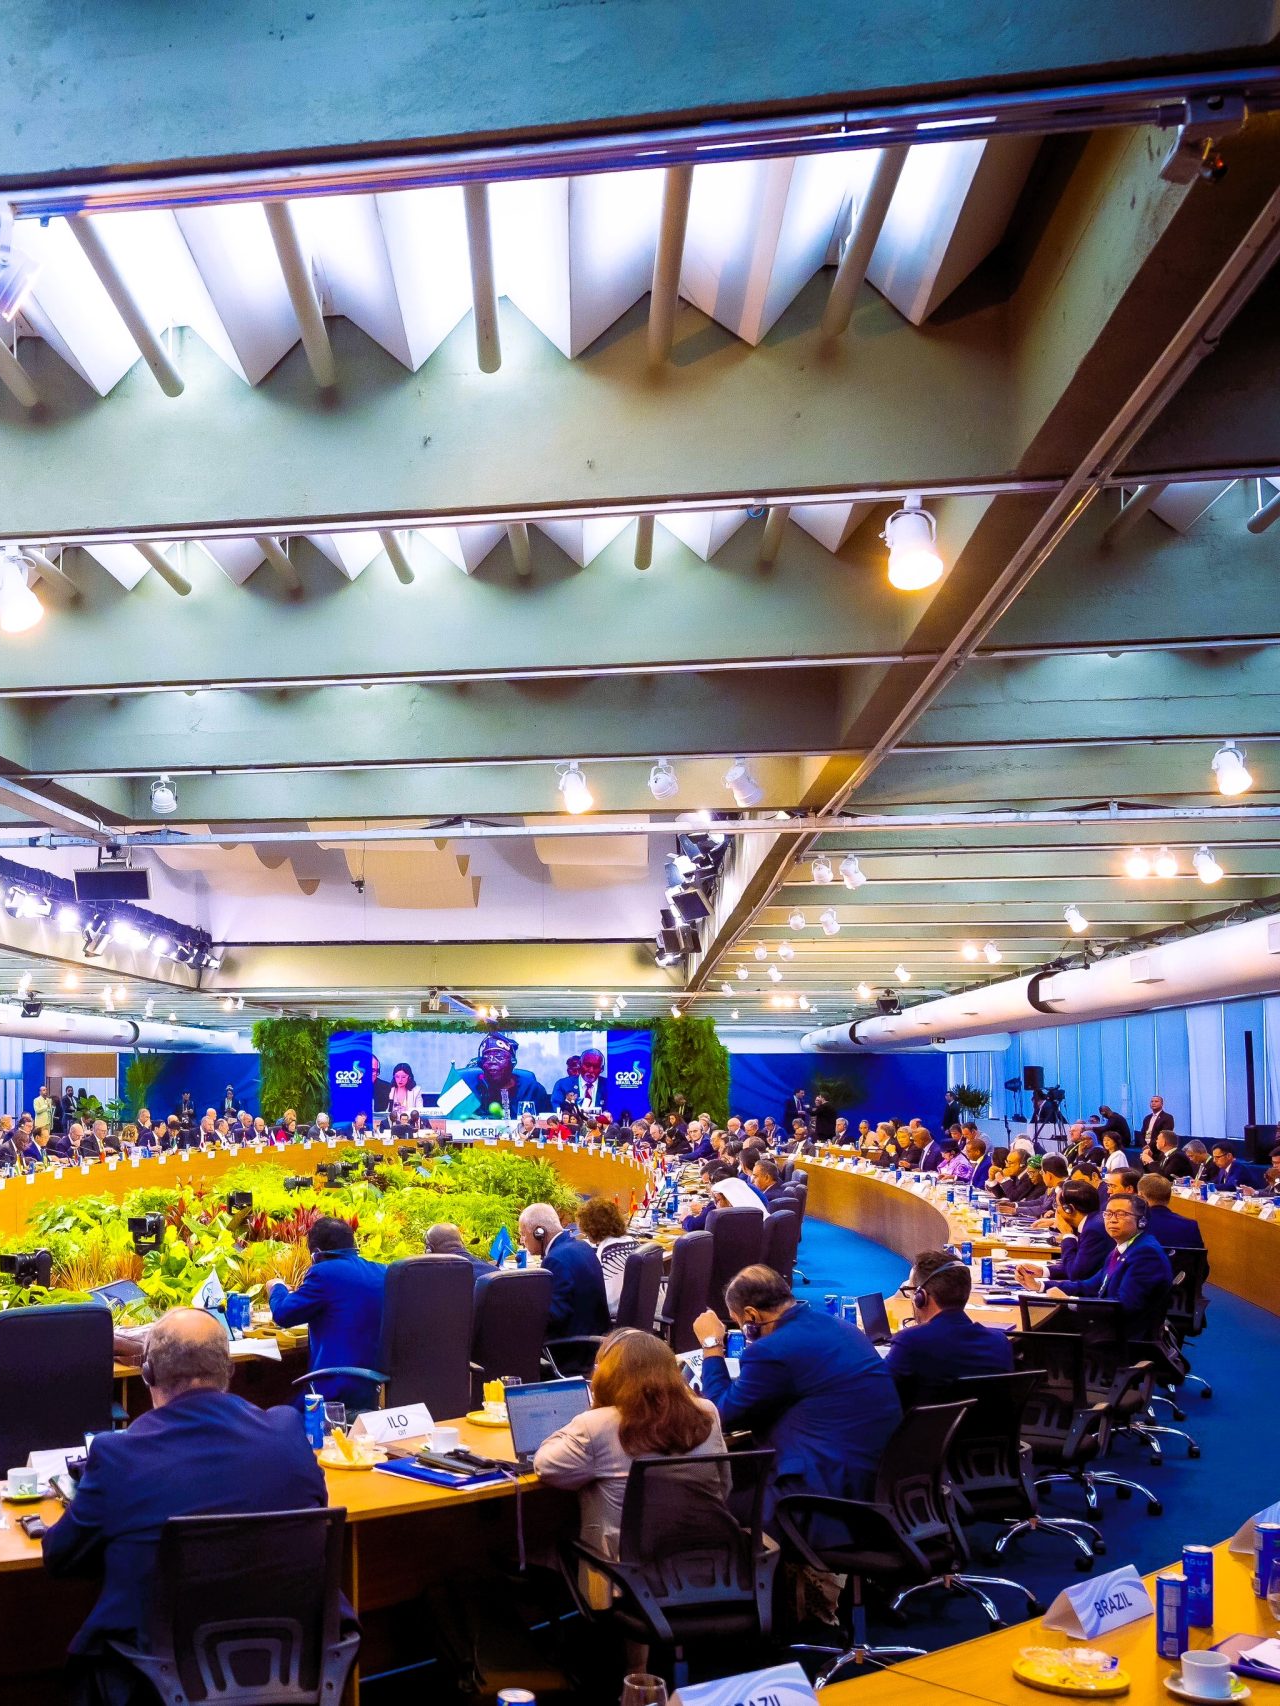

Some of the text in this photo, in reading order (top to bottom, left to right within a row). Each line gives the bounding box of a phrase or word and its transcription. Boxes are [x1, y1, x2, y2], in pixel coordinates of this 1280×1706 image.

[335, 1071, 358, 1080] G20
[615, 1072, 638, 1081] G20
[387, 1414, 408, 1428] ILO
[1094, 1591, 1133, 1618] BRAZIL
